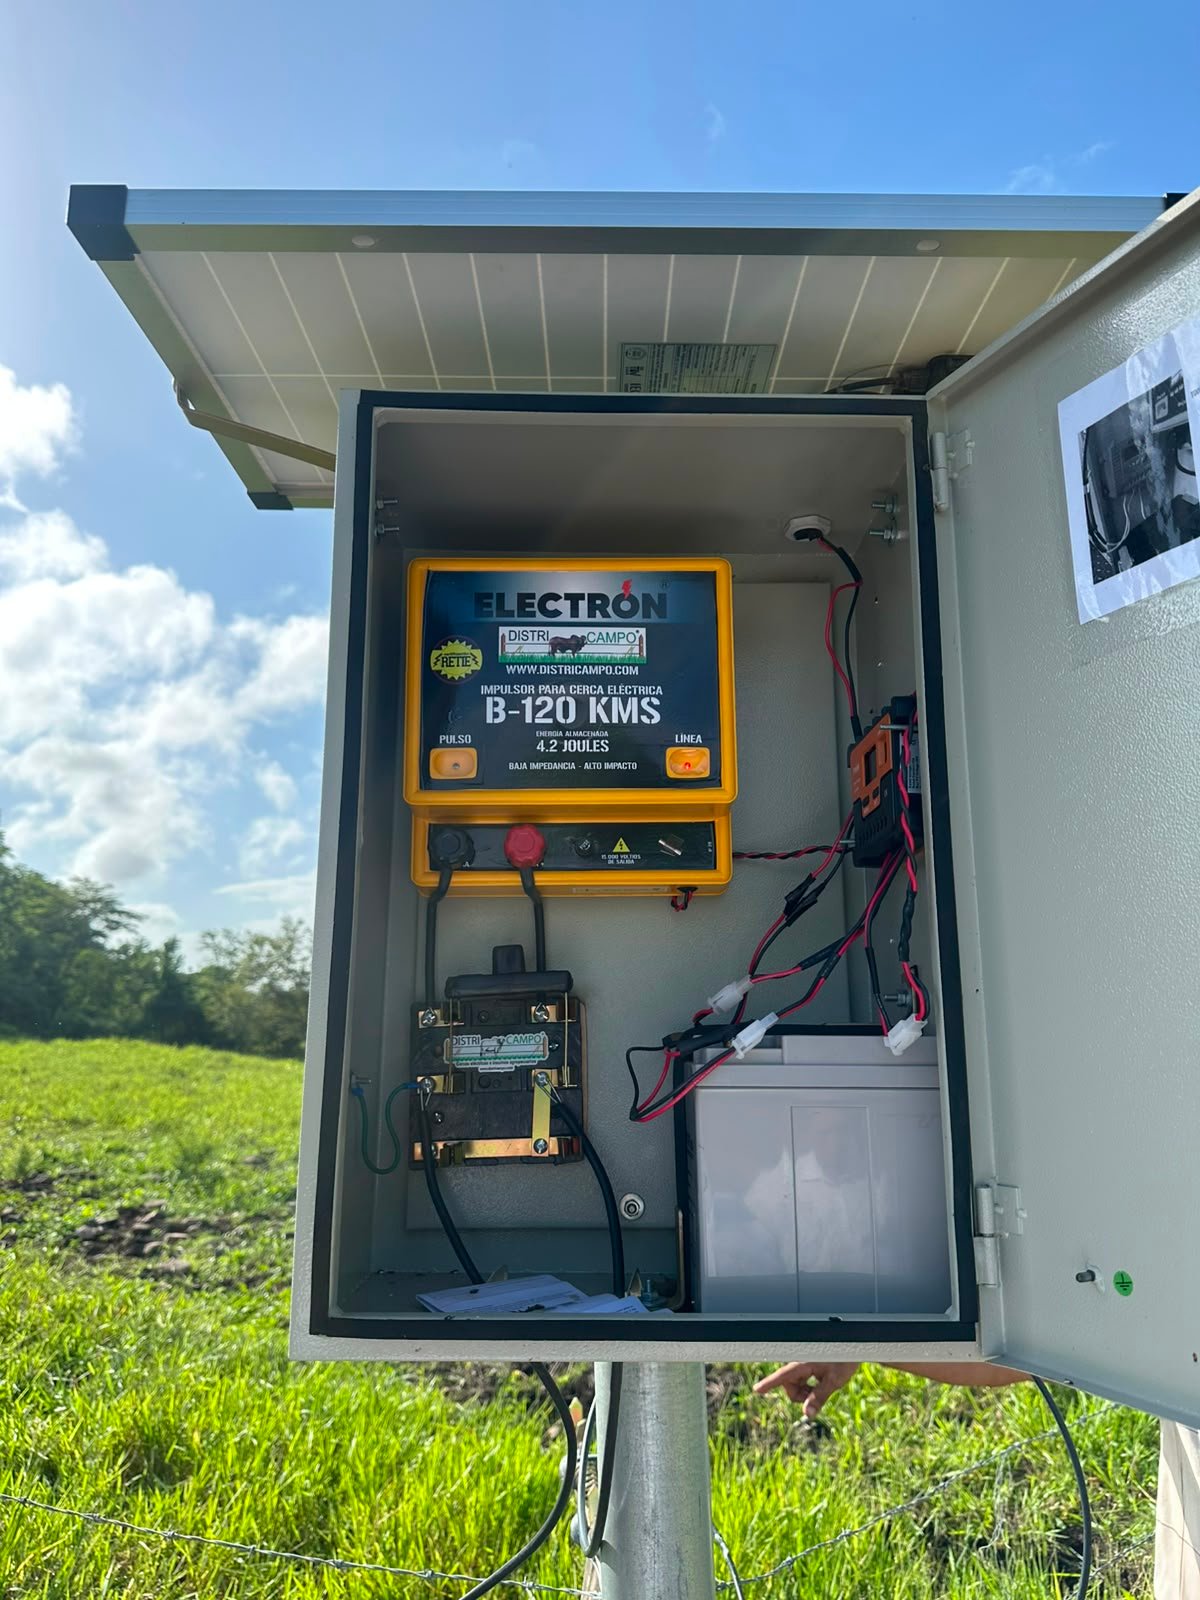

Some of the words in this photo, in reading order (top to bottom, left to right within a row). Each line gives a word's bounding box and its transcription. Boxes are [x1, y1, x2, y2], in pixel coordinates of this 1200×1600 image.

[508, 630, 550, 642] DISTRI
[586, 631, 637, 643] CAMPO
[505, 664, 639, 675] WWW.DISTRICAMPO.COM
[480, 684, 535, 695] IMPULSOR
[538, 684, 566, 695] PARA
[569, 684, 604, 695] CERCA
[607, 683, 663, 696] ELÉCTRICA
[485, 696, 576, 724] B-120
[589, 696, 661, 724] KMS
[439, 734, 472, 744] PULSO
[536, 739, 558, 752] 4.2
[561, 739, 610, 752] JOULES
[508, 762, 527, 770] BAJA
[529, 762, 576, 770] IMPEDANCIA
[583, 762, 602, 770] ALTO
[604, 762, 638, 770] IMPACTO
[452, 1036, 480, 1046] DISTRI
[506, 1034, 541, 1045] CAMPO
